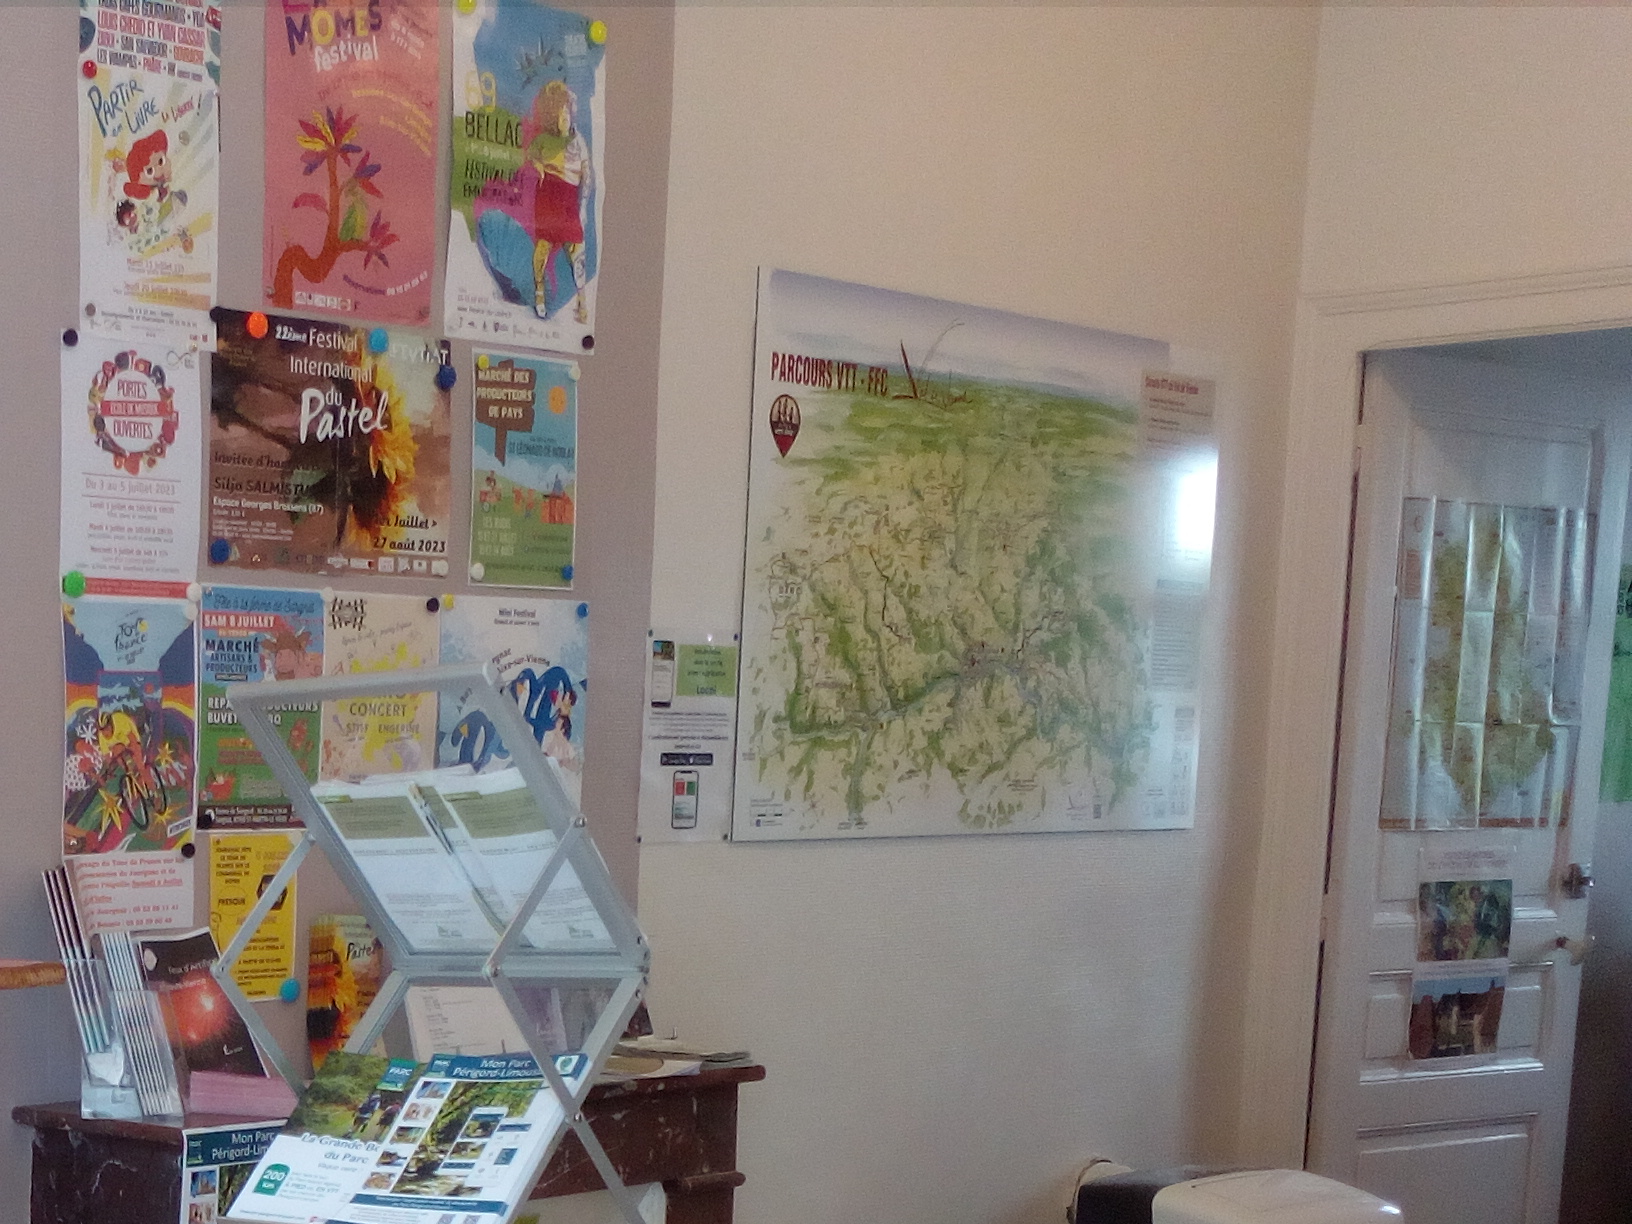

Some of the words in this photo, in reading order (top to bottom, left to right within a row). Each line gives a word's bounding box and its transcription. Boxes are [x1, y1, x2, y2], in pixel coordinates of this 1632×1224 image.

[465, 111, 523, 149] BELLAC
[309, 328, 359, 350] Festival
[290, 355, 373, 383] International
[771, 351, 833, 390] PARCOURS
[837, 361, 858, 393] VTT
[868, 365, 888, 397] FFC
[118, 379, 147, 400] PORTES
[326, 387, 343, 406] du
[300, 387, 389, 445] Pastel
[502, 407, 523, 420] PAYS
[113, 420, 153, 440] OUVERTES
[419, 538, 447, 554] 2023
[204, 614, 226, 627] SAM
[237, 614, 275, 628] JUILLET
[205, 637, 259, 654] MARCHÉ
[349, 702, 408, 717] CONCERT
[389, 1065, 413, 1077] PARC
[480, 1058, 506, 1069] Mon
[452, 1067, 545, 1081] Périgord-Limous
[232, 1132, 254, 1144] Mon
[212, 1144, 269, 1160] Périgord-Lim
[263, 1169, 286, 1182] 200
